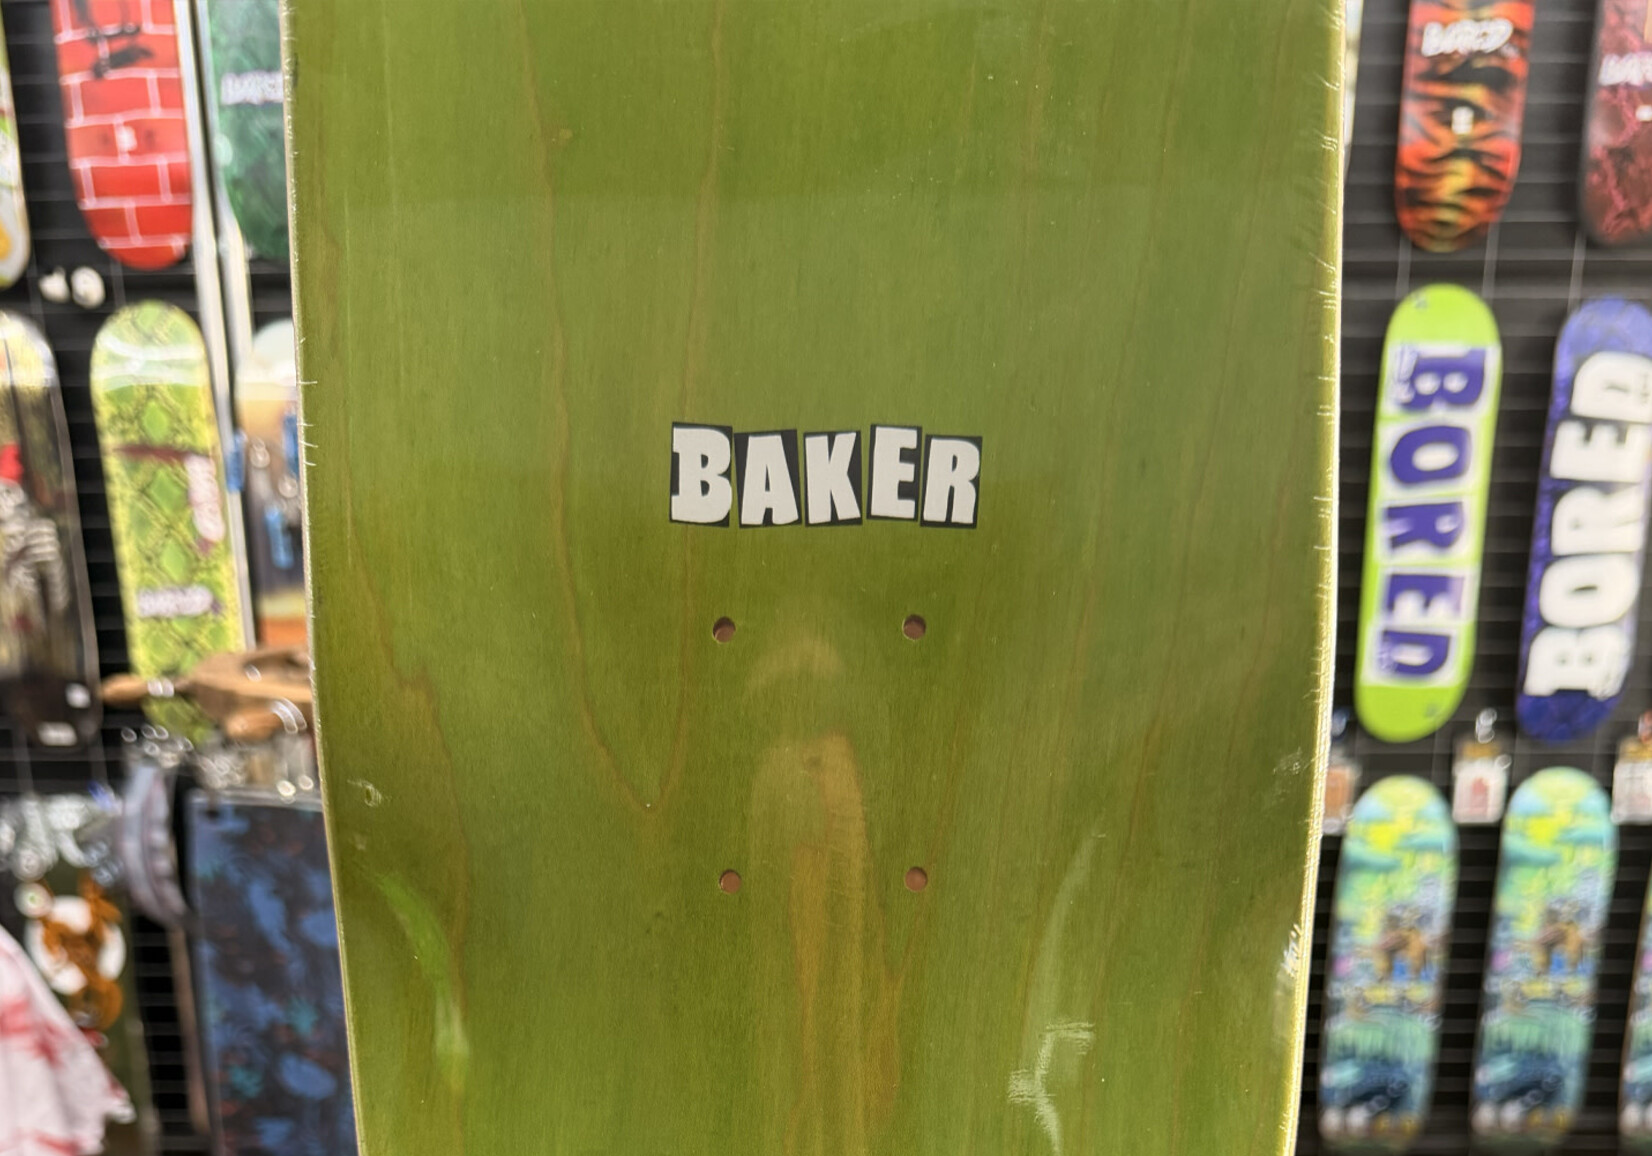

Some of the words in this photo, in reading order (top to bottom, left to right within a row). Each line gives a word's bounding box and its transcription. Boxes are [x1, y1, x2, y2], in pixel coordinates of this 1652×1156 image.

[669, 422, 983, 528] BAKER
[1382, 346, 1487, 679] BORED
[1523, 350, 1652, 701] BORED
